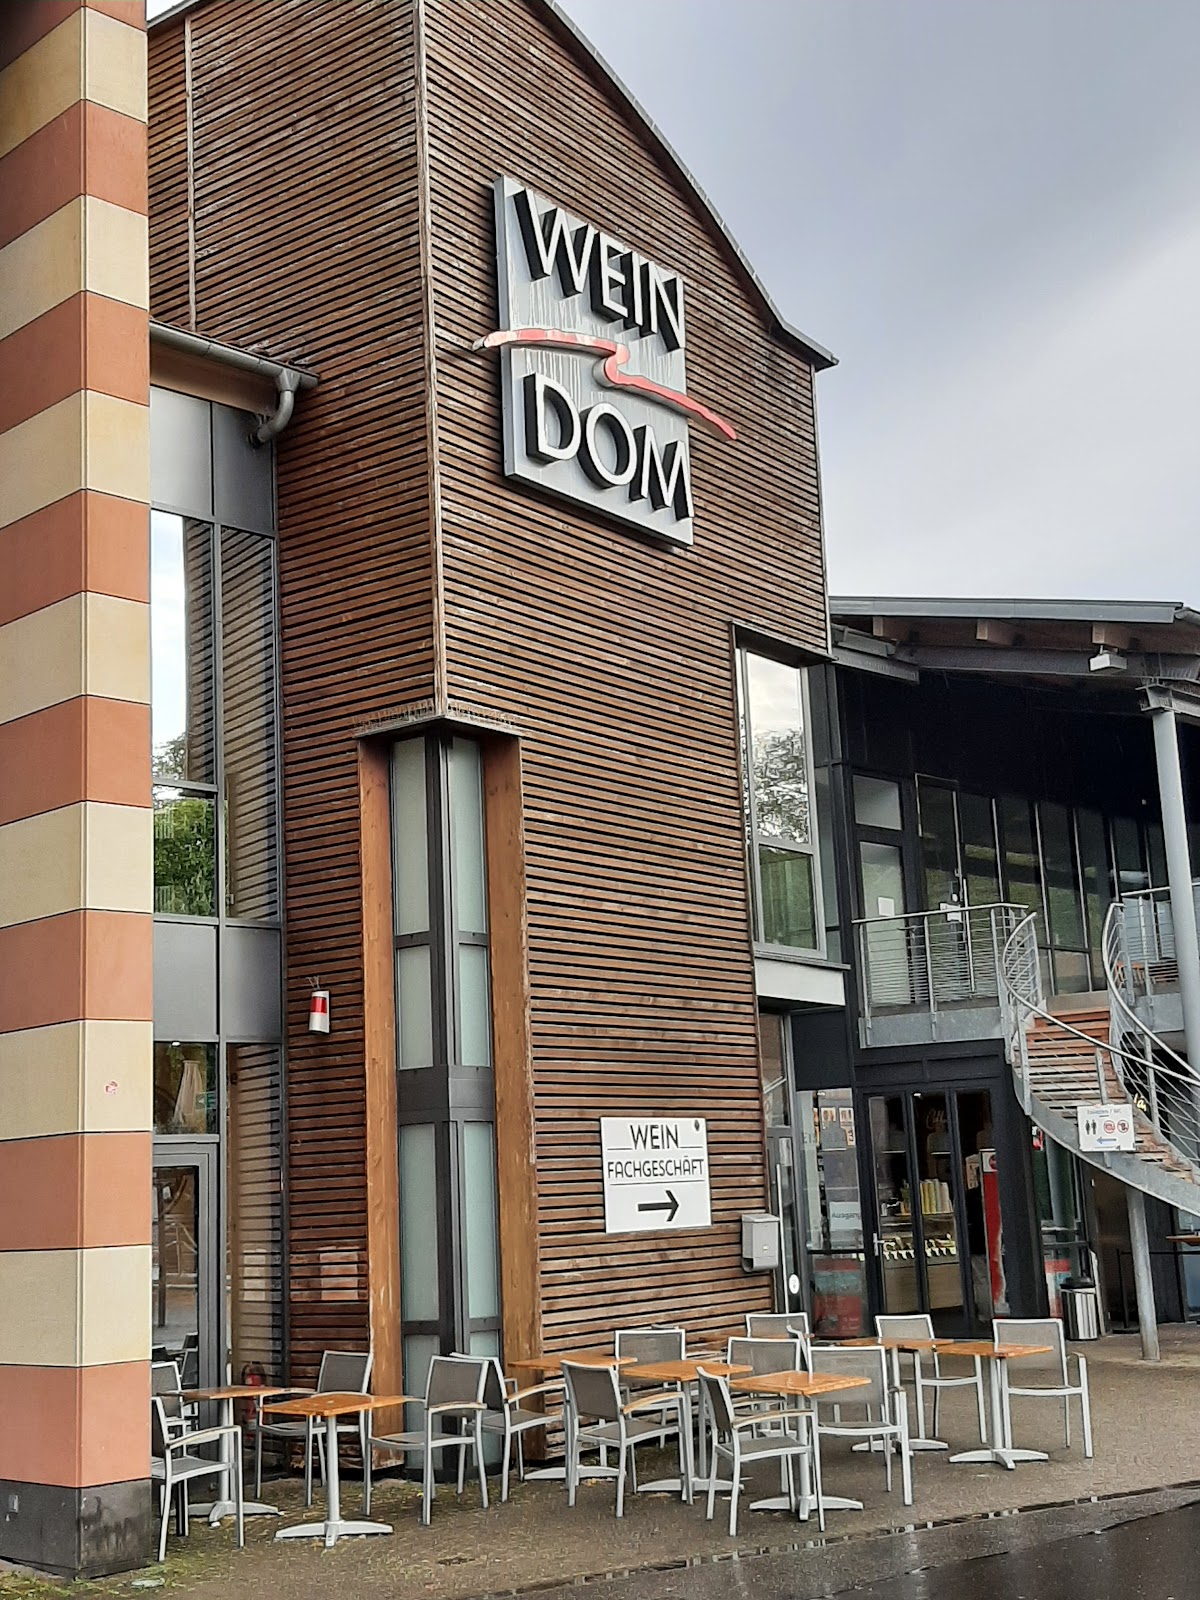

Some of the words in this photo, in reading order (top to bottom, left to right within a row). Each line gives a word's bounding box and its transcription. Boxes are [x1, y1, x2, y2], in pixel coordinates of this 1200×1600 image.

[514, 188, 685, 352] WEIN
[524, 372, 694, 521] DOM
[607, 1155, 704, 1179] FACHGESCHÄFT
[630, 1124, 679, 1150] WEIN
